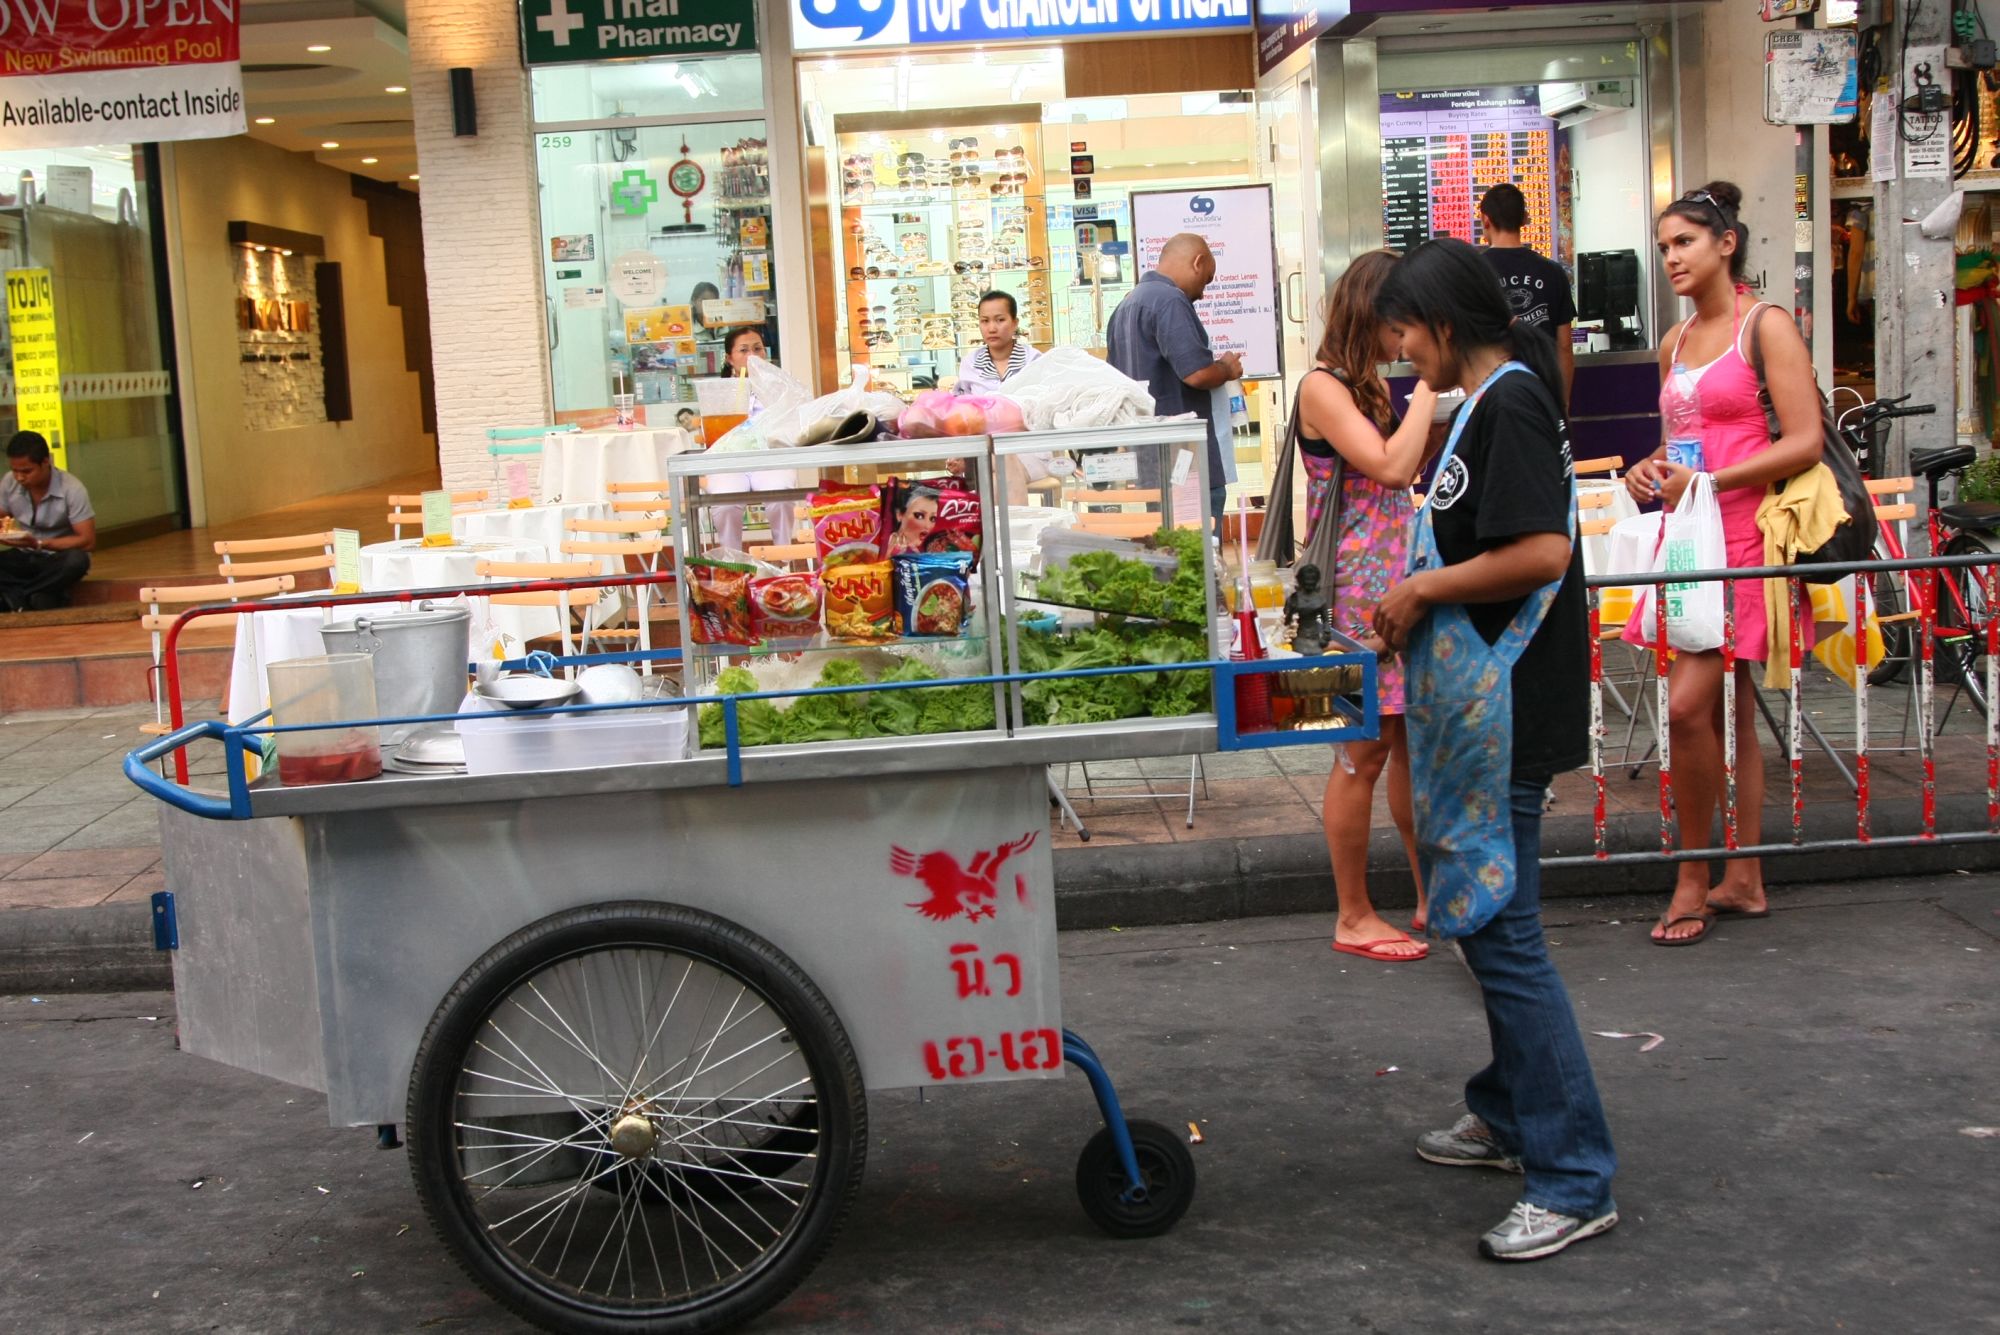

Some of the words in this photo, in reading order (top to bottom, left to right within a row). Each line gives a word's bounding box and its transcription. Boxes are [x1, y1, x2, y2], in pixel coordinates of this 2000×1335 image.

[597, 22, 741, 49] Pharmacy
[6, 51, 51, 71] New
[60, 42, 170, 67] Swimming
[175, 36, 222, 59] Pool
[3, 90, 180, 126] Available-contact
[185, 86, 240, 115] Inside
[1451, 100, 1475, 108] Foreign
[1477, 99, 1507, 107] Exchange
[1448, 111, 1469, 120] Buying
[1909, 114, 1943, 124] TATTOO
[1395, 120, 1422, 128] Currency
[541, 136, 572, 149] 259
[1076, 206, 1097, 215] VISA
[1220, 274, 1240, 282] Contact
